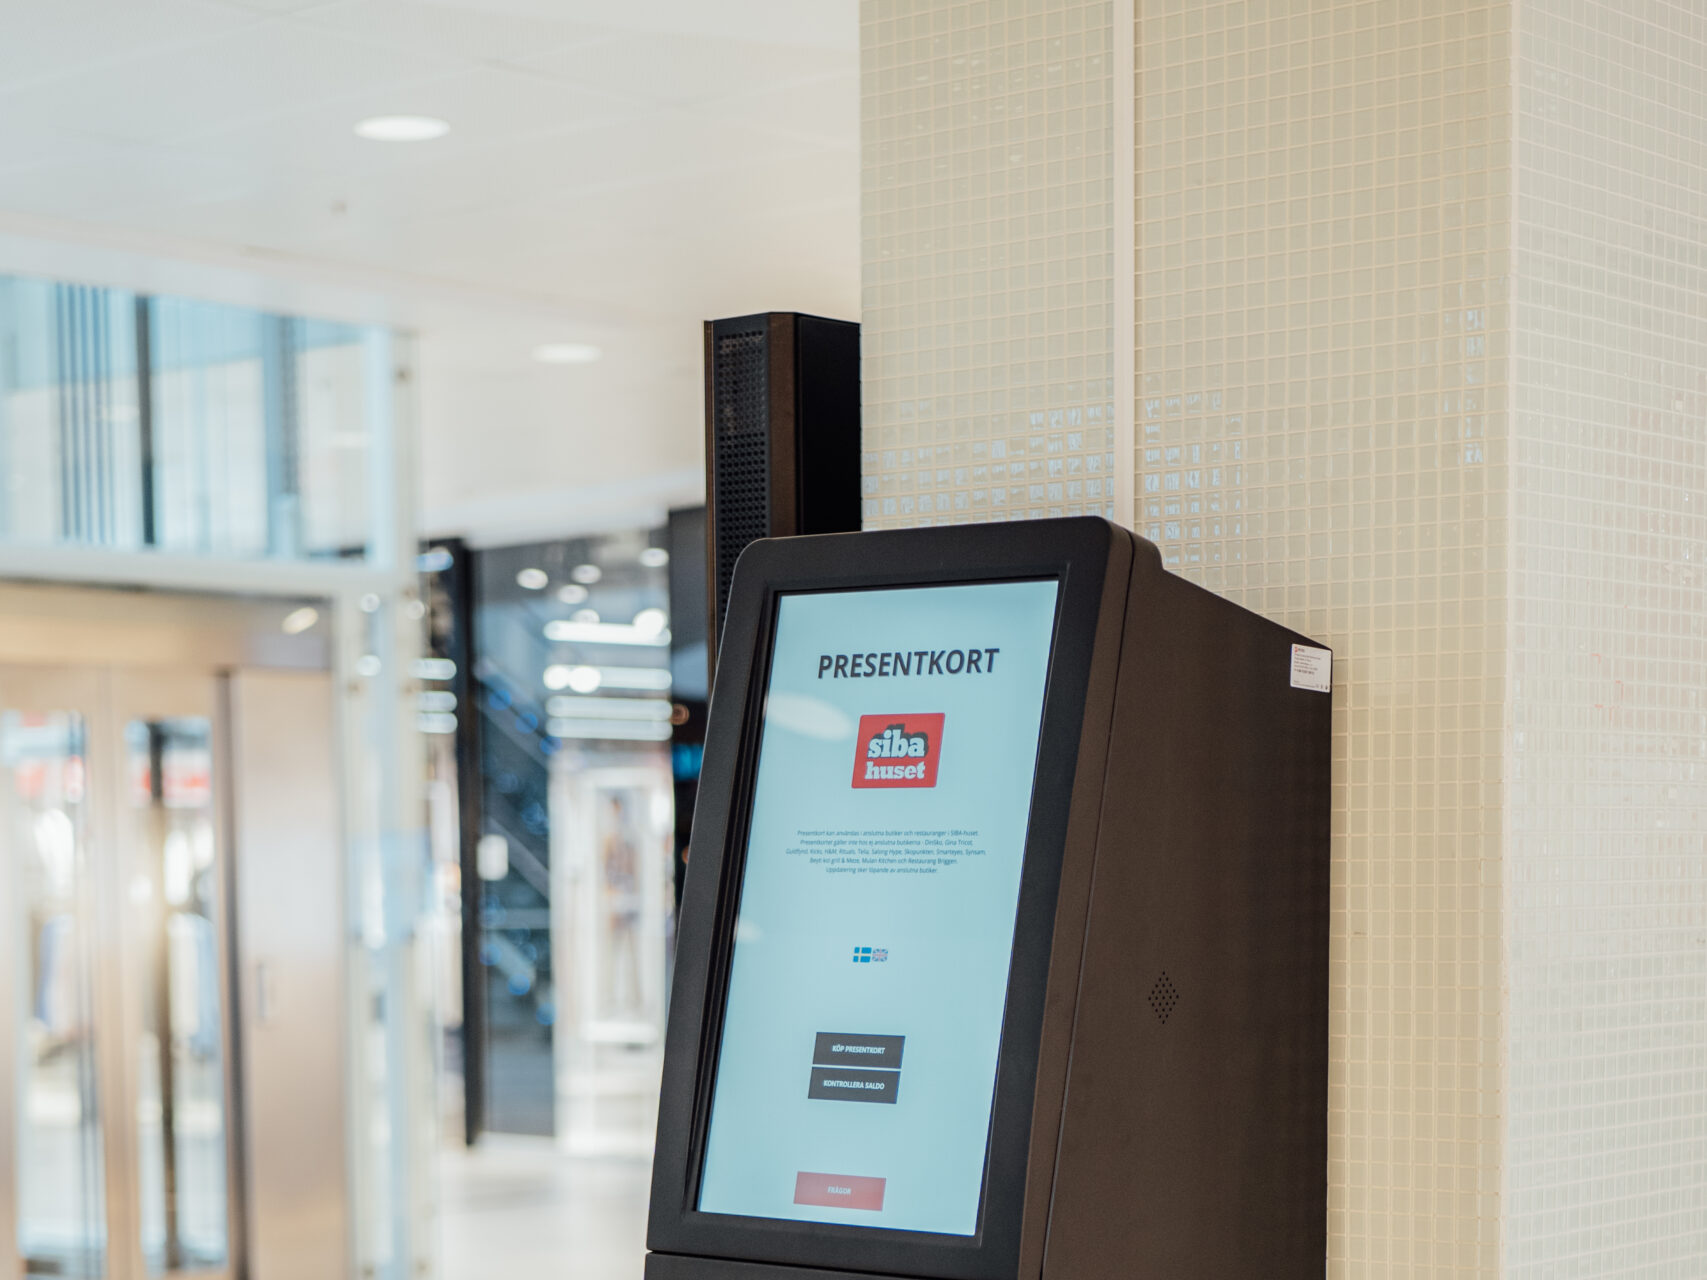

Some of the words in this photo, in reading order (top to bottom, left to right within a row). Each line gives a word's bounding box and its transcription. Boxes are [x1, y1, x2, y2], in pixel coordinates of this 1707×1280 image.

[818, 648, 1000, 679] PRESENTKORT
[866, 727, 927, 759] siba
[864, 761, 926, 780] huset
[832, 1043, 845, 1052] KÖP
[845, 1045, 886, 1054] PRESENTKORT
[823, 1079, 864, 1088] KONTROLLERA
[865, 1081, 885, 1090] SALDO
